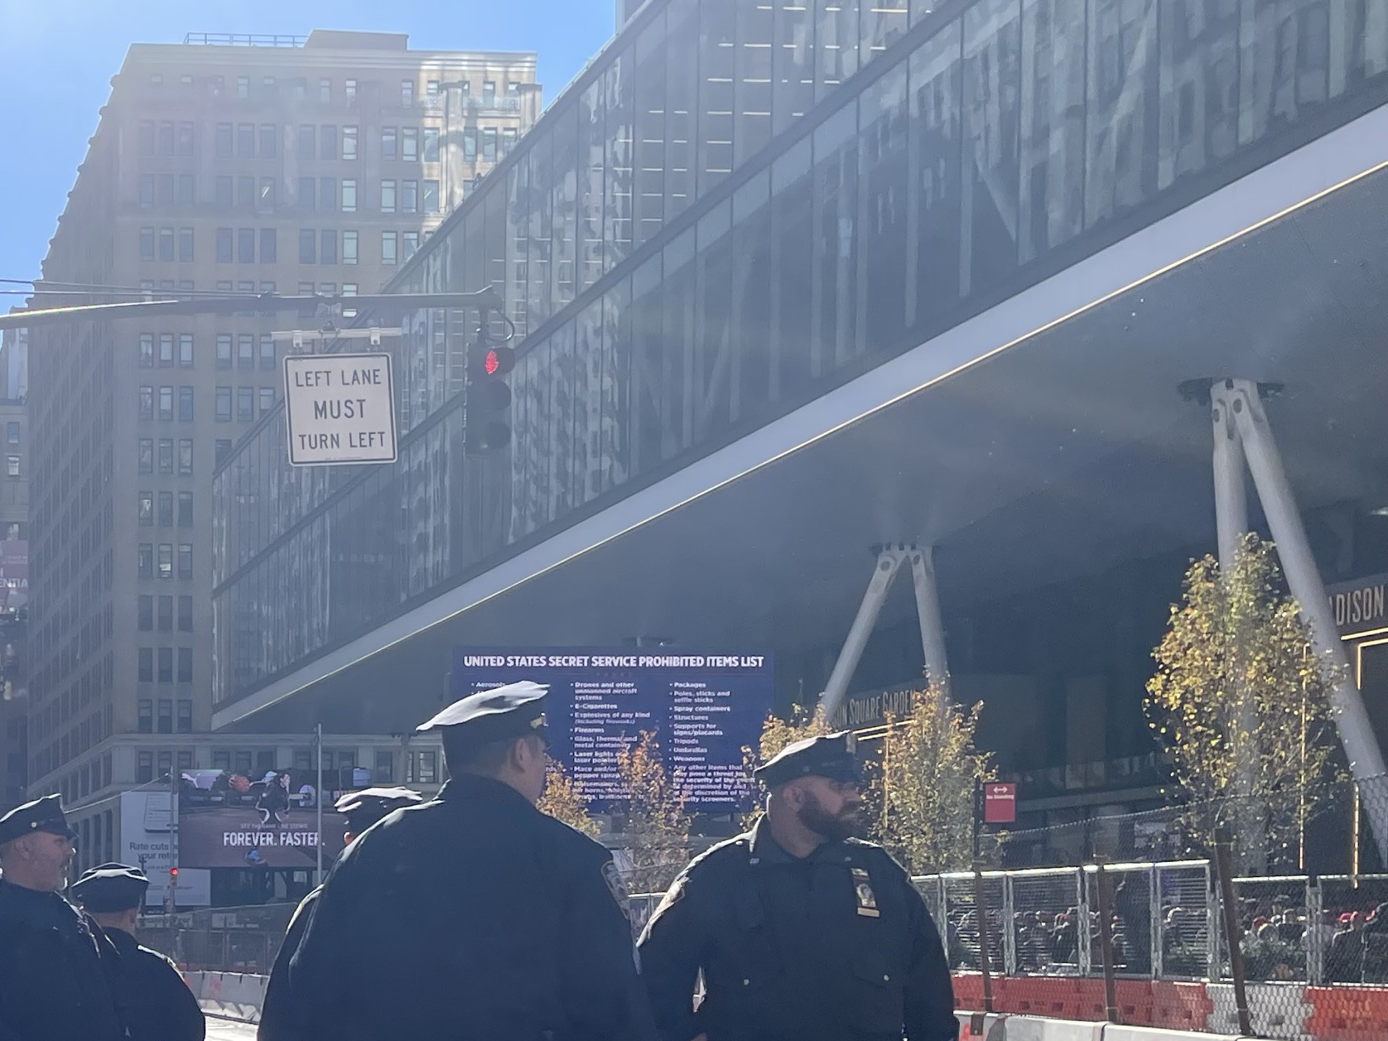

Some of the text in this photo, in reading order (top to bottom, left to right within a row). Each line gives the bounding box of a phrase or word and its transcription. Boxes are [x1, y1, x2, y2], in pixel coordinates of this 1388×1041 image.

[294, 368, 381, 388] LEFT LANE
[313, 398, 366, 420] MUST
[299, 431, 386, 450] TURN LEFT
[1329, 584, 1385, 626] DISON
[464, 656, 764, 667] UNITED STATES SECRET SERVICE PROHIBITED ITEMS LIST
[129, 842, 169, 851] Rate cuts
[223, 831, 278, 847] FOREVER.
[138, 852, 157, 861] your
